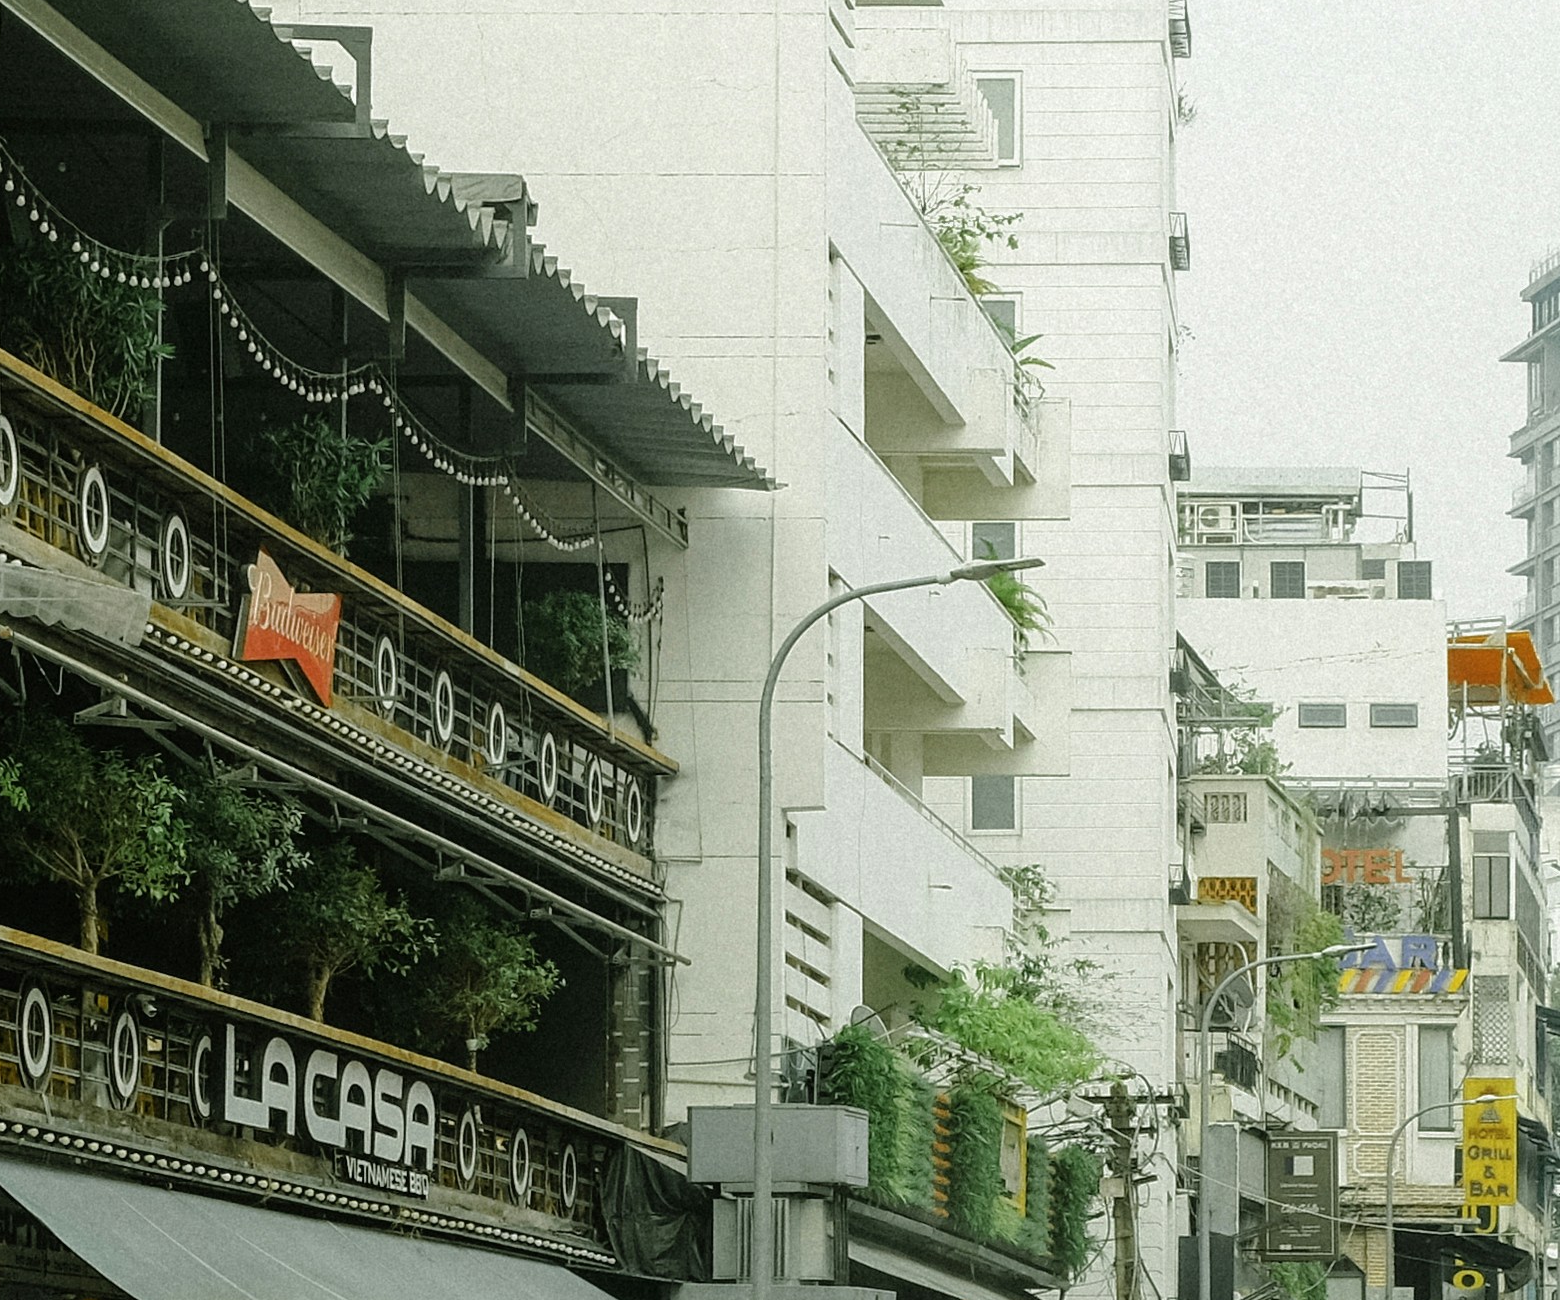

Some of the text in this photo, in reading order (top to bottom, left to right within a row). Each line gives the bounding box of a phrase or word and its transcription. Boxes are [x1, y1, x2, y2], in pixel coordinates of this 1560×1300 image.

[247, 564, 339, 663] Budweiser
[1322, 849, 1413, 884] OTEL
[345, 1153, 430, 1201] VIETNAMESE BBQ
